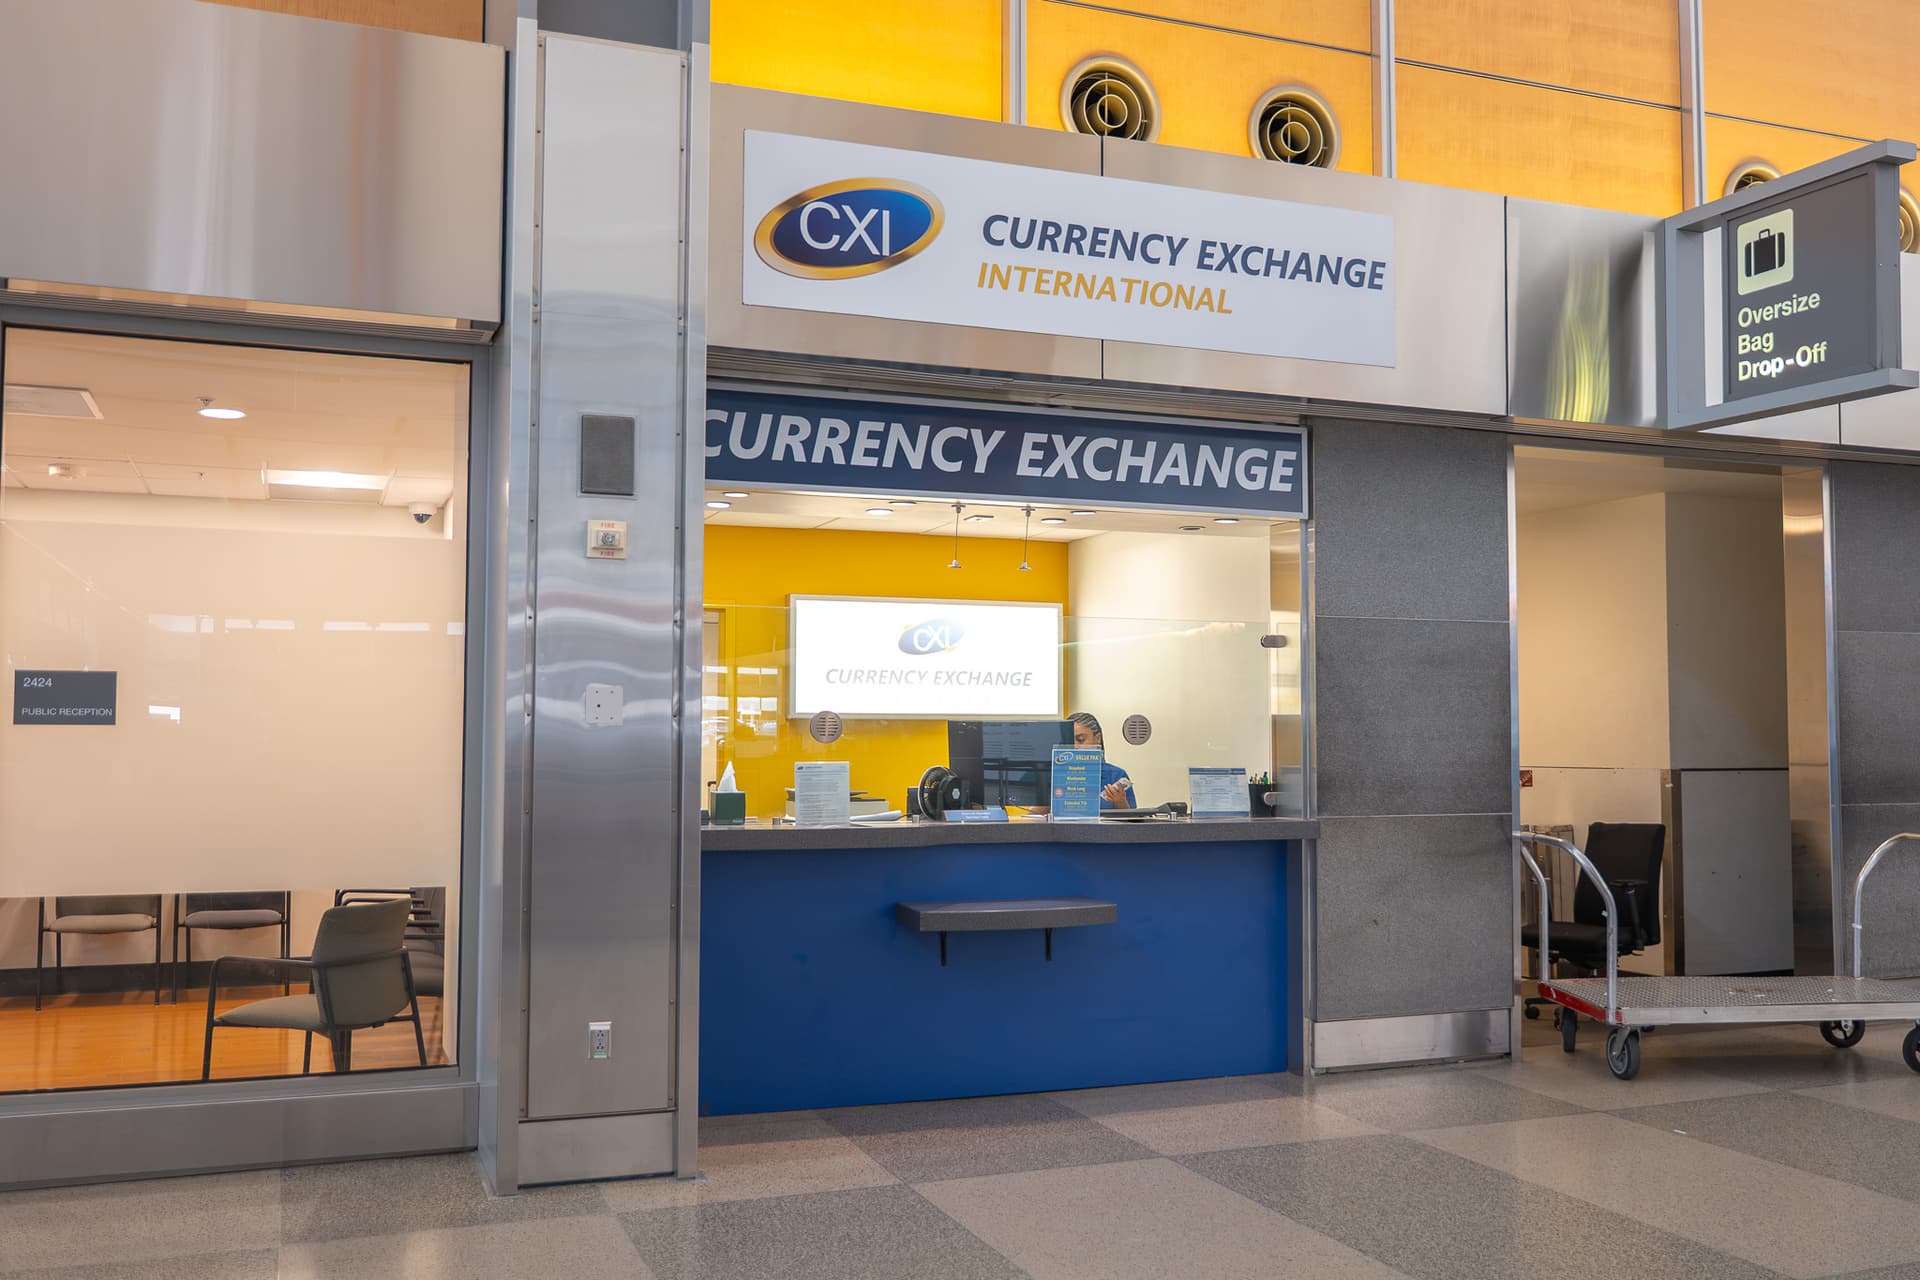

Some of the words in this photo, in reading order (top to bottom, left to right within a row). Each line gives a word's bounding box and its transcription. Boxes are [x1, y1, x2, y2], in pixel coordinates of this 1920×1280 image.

[798, 200, 890, 257] CXI
[982, 214, 1190, 267] CURRENCY
[1196, 239, 1387, 291] EXCHANGE
[977, 261, 1233, 315] INTERNATIONAL
[1738, 292, 1821, 328] Oversize
[1738, 331, 1774, 355] Bag
[1738, 341, 1828, 381] Drop-Off
[1016, 432, 1298, 493] EXCHANGE
[912, 624, 950, 652] CXI
[23, 677, 52, 687] 2424
[825, 668, 928, 686] CURRENCY
[933, 670, 1033, 687] EXCHANGE
[22, 707, 57, 716] PUBLIC
[59, 708, 113, 716] RECEPTION
